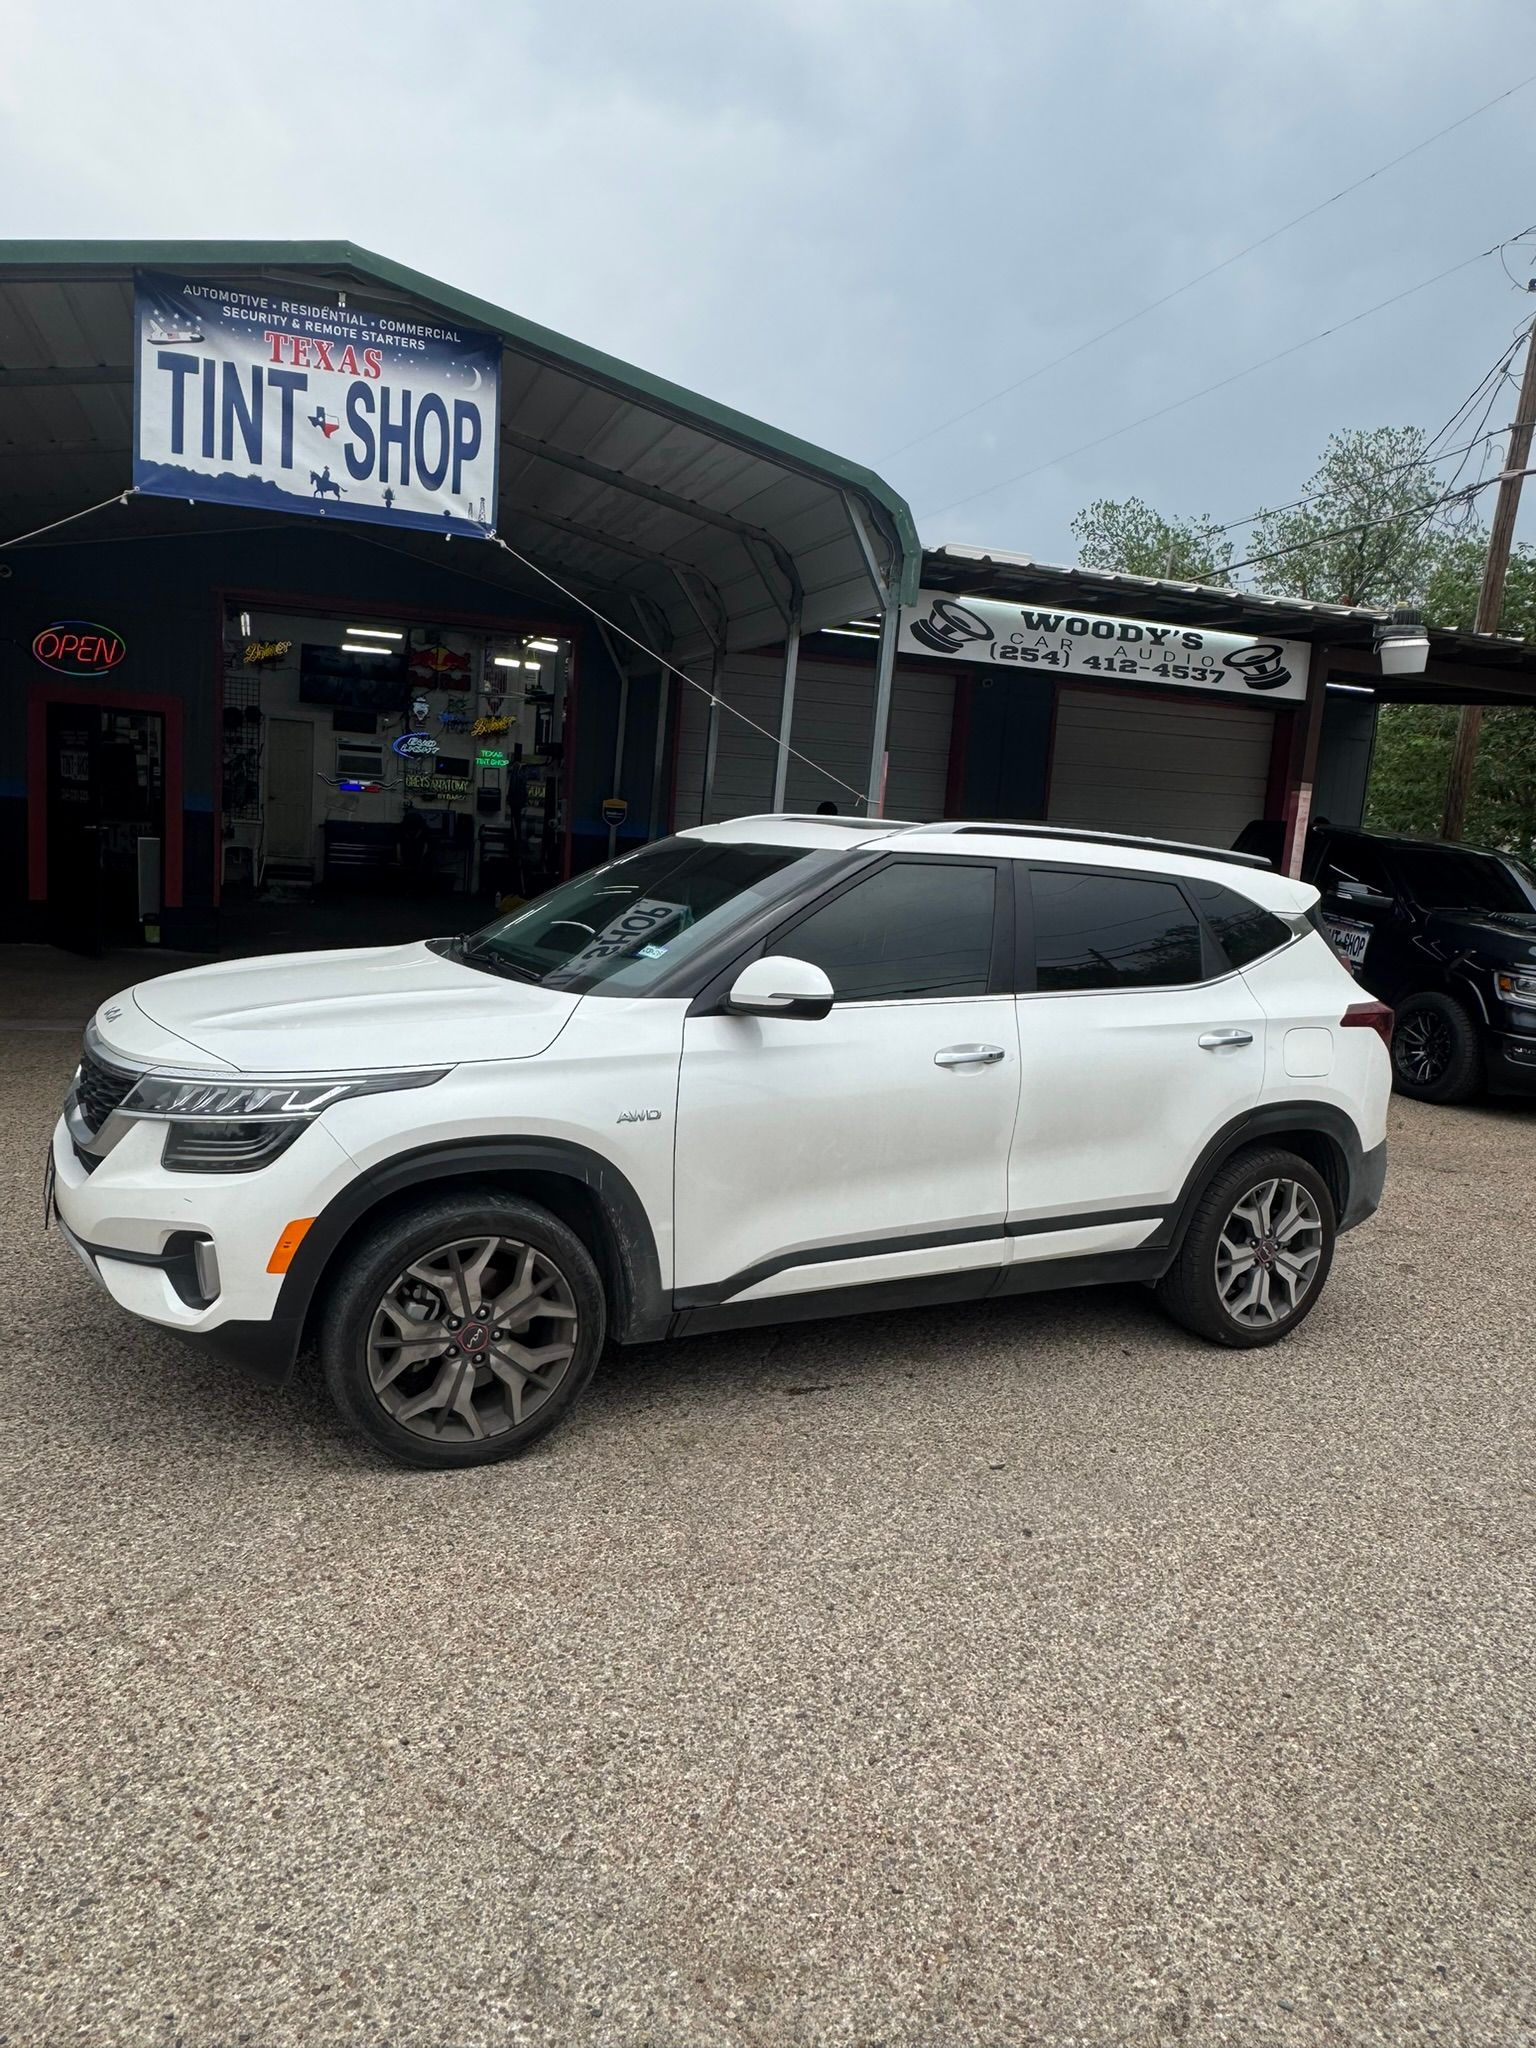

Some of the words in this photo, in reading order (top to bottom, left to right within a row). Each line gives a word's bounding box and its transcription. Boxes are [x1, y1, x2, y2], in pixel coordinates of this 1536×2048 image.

[183, 284, 269, 309] AUTOMOTIVE
[281, 301, 367, 327] RESIDENTIAL
[379, 319, 461, 343] COMMERCIAL
[222, 305, 288, 327] SECURITY
[291, 318, 301, 329] &
[305, 320, 358, 339] REMOTE
[361, 330, 426, 350] STARTERS
[263, 331, 383, 380] TEXAS
[157, 350, 308, 470] TINT
[343, 380, 482, 495] SHOP
[37, 633, 119, 664] OPEN
[1010, 632, 1073, 651] CAR
[1113, 645, 1215, 667] AUDIO
[1021, 610, 1203, 650] WOODY'S
[990, 641, 1070, 668] (254)
[1082, 655, 1225, 684] 412-4537
[616, 1109, 662, 1124] AWD
